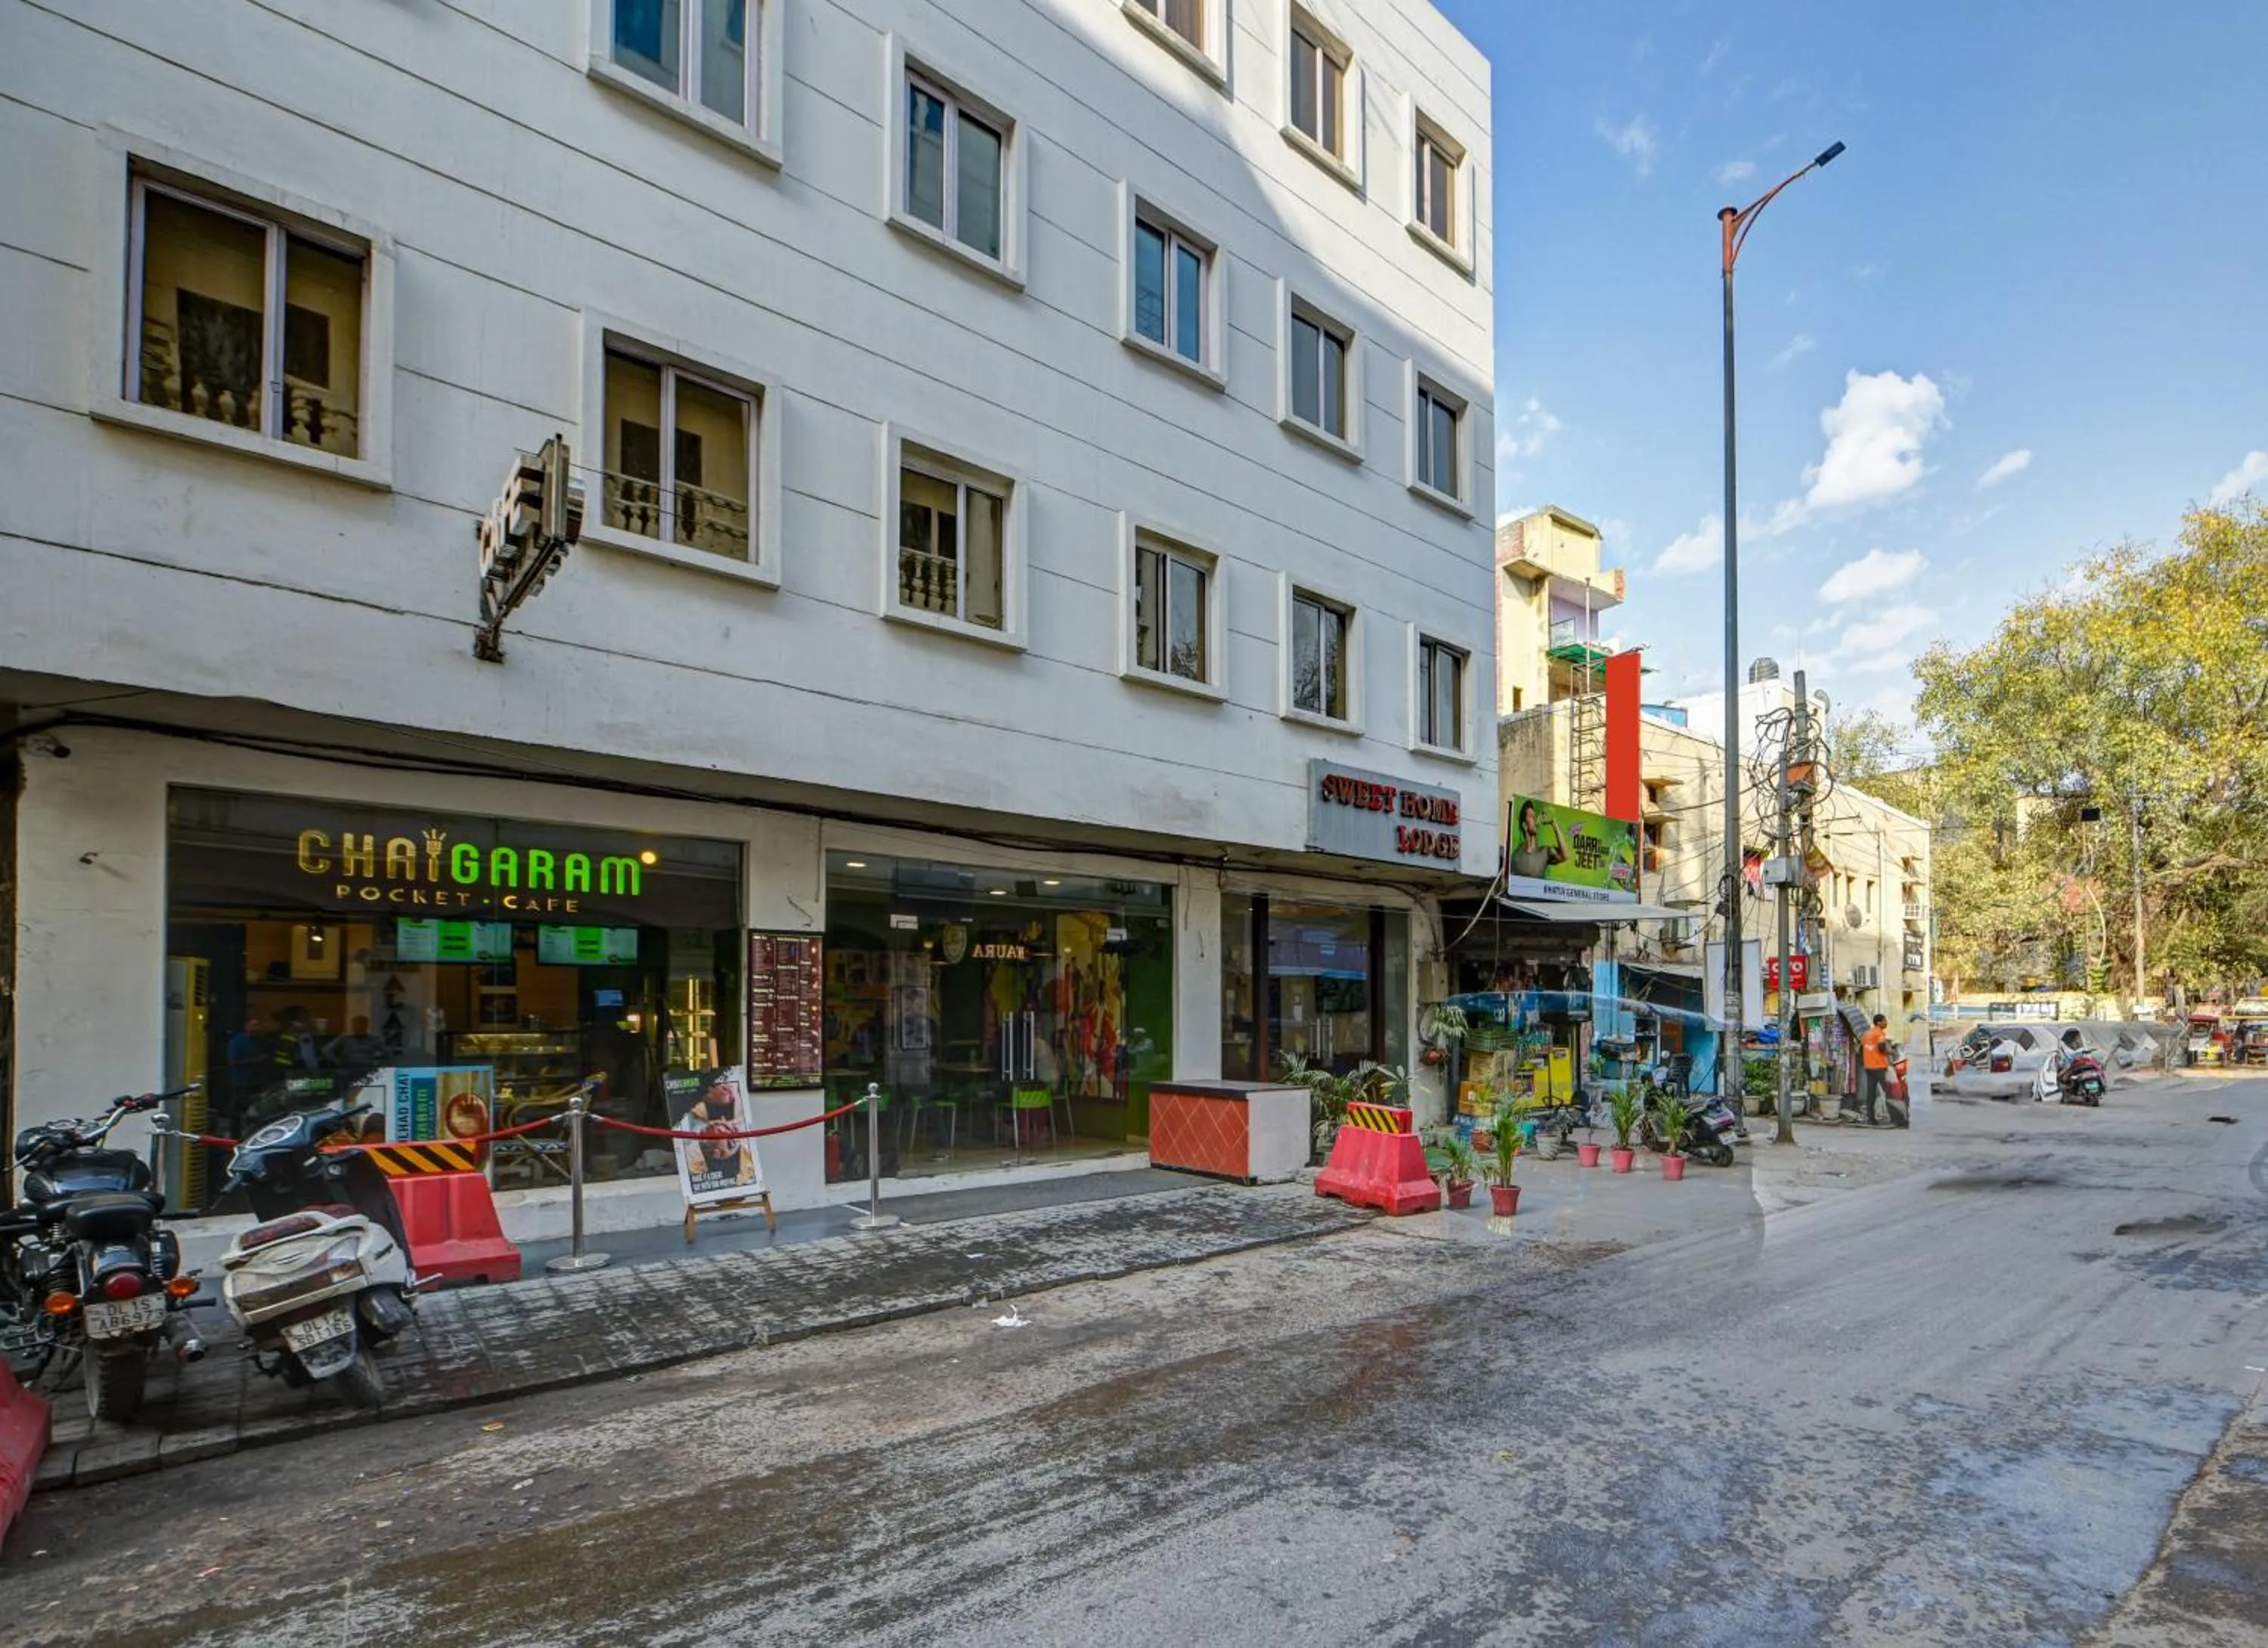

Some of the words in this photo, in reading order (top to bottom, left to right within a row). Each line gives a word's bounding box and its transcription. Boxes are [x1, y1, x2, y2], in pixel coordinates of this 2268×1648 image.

[1323, 773, 1396, 813] SWEET
[1400, 790, 1458, 826] HOME
[1396, 823, 1460, 860] LODGE
[336, 884, 470, 906] POCKET
[503, 894, 579, 913] CAFE
[1771, 961, 1803, 974] OO
